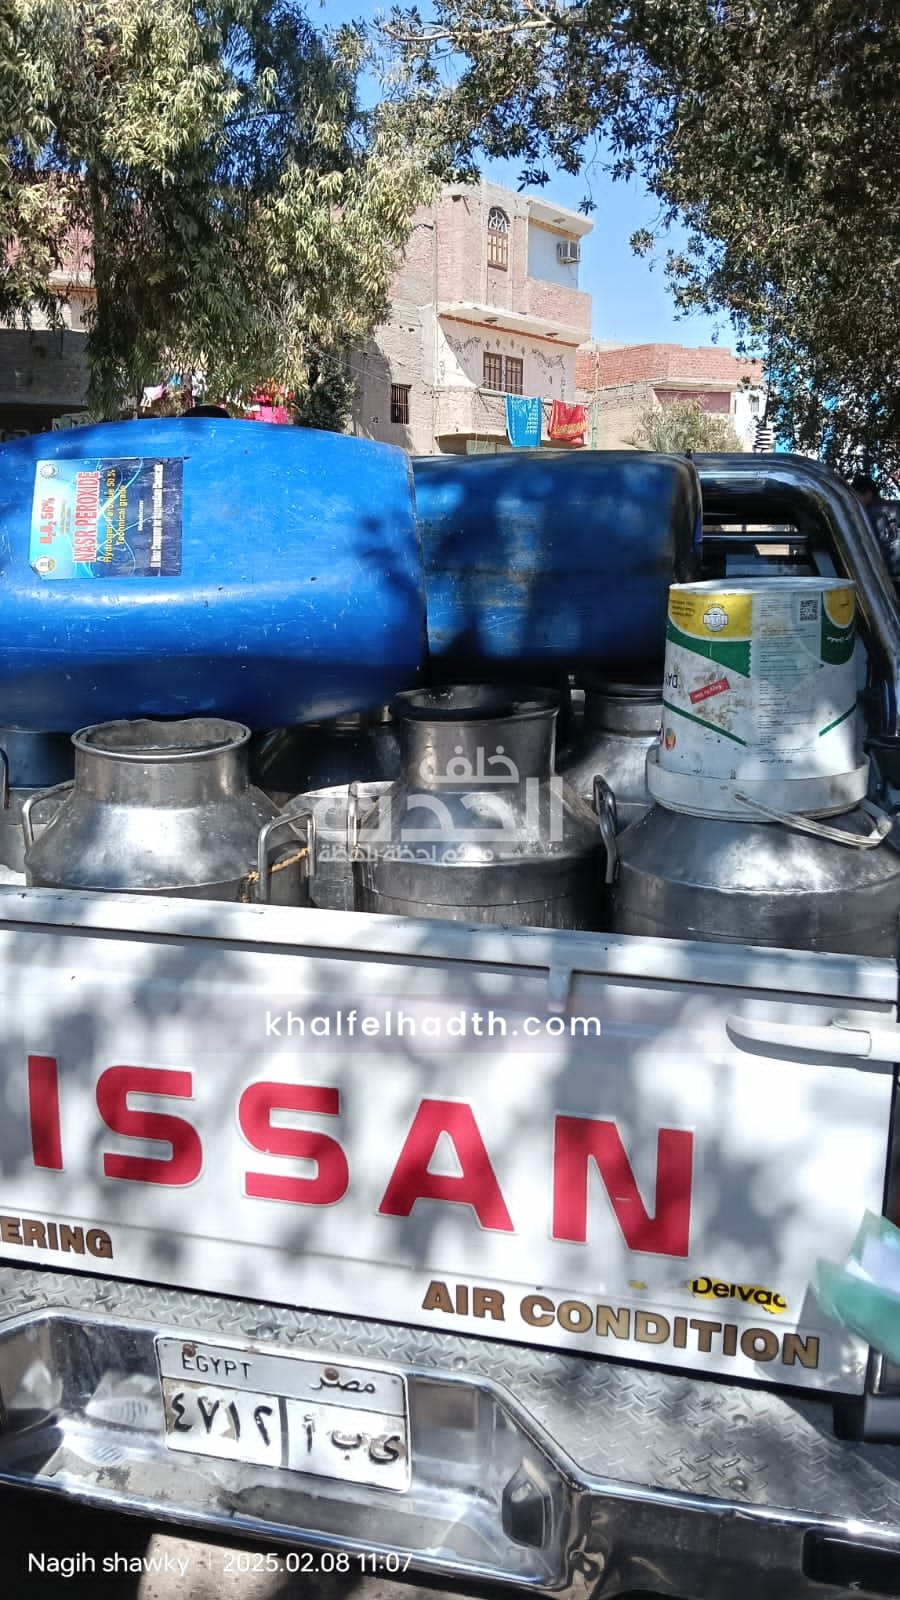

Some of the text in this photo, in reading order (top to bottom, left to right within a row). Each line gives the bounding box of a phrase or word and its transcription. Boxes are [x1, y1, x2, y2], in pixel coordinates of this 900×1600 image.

[73, 471, 99, 562] NASR PEROXIDE
[117, 508, 126, 545] Technical
[27, 1053, 694, 1258] ISSAN
[692, 1276, 787, 1308] Delvac
[422, 1280, 820, 1369] AIR CONDITION
[182, 1351, 253, 1381] EGYPT
[310, 1373, 377, 1395] مصر
